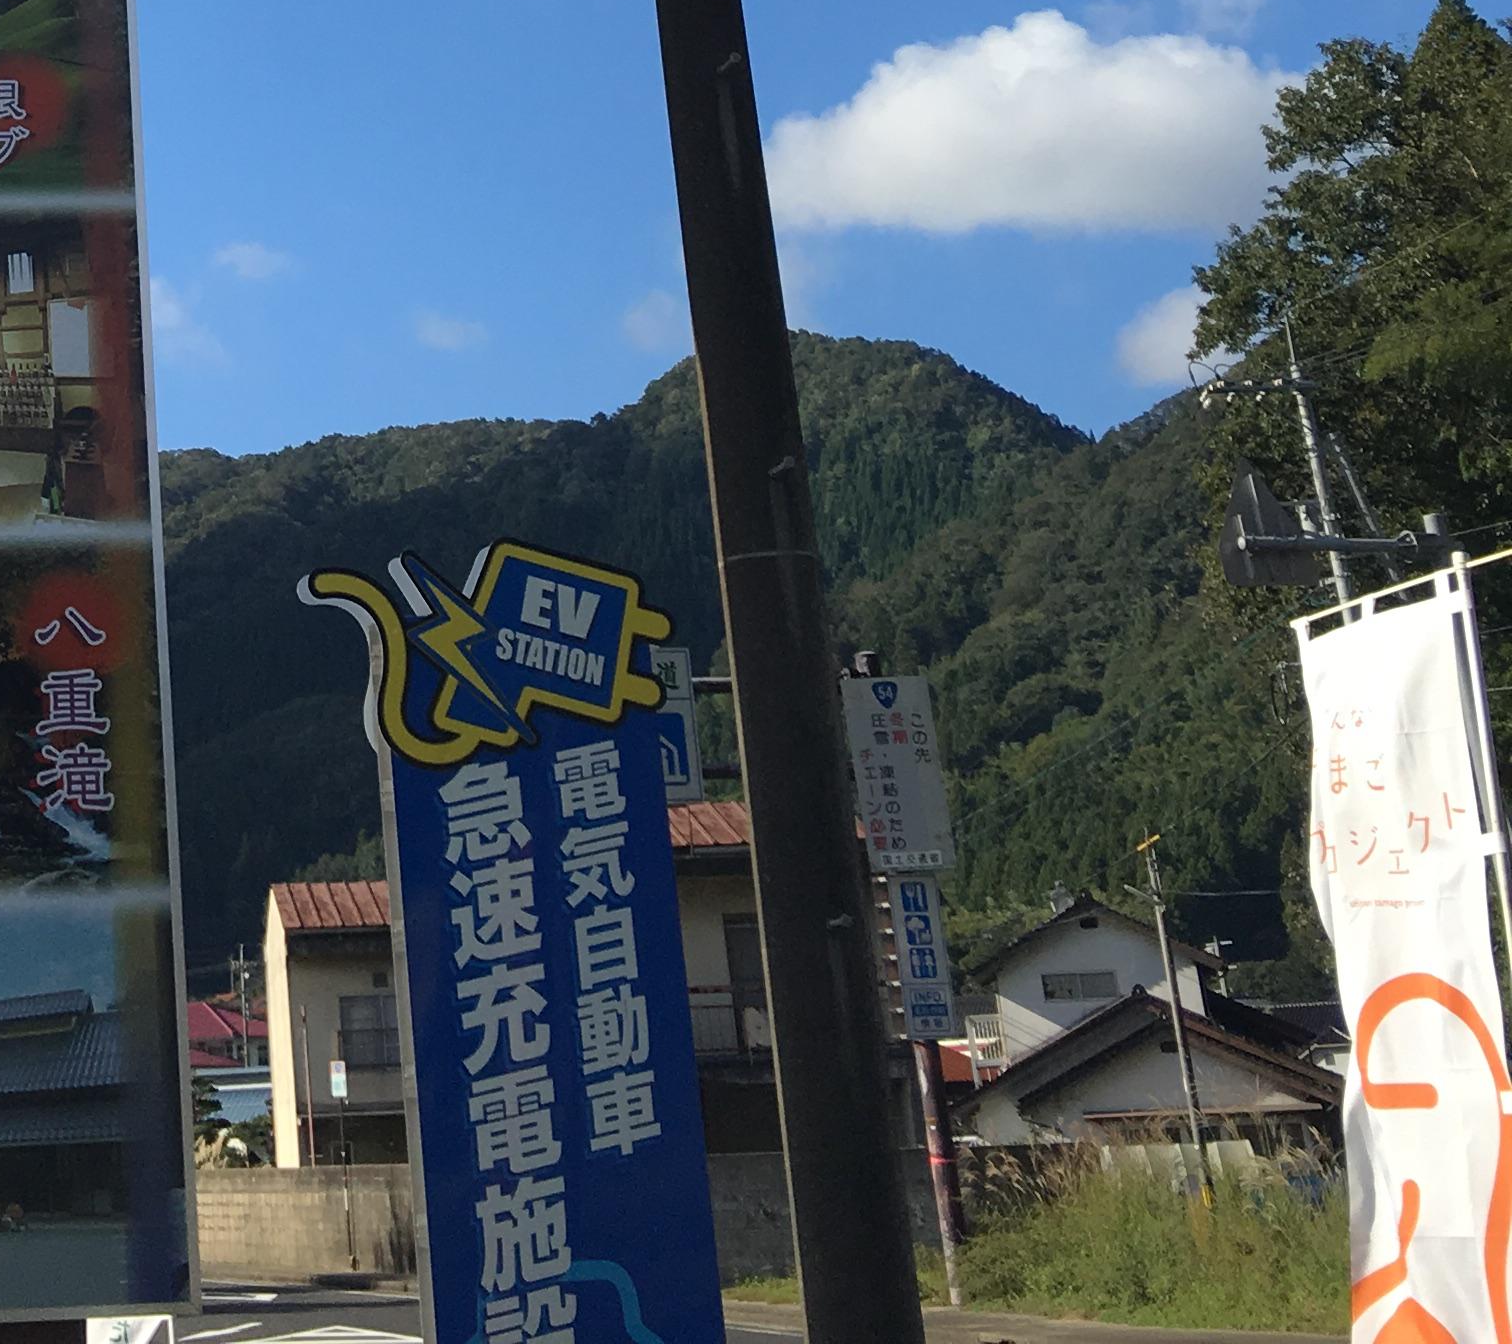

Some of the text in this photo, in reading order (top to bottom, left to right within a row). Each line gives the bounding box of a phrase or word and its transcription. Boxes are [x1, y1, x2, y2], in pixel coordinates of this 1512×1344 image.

[519, 575, 601, 640] EV
[495, 627, 606, 688] STATION
[34, 605, 115, 814] 八重滝
[910, 712, 932, 764] この先
[552, 739, 663, 1156] 電気自動車
